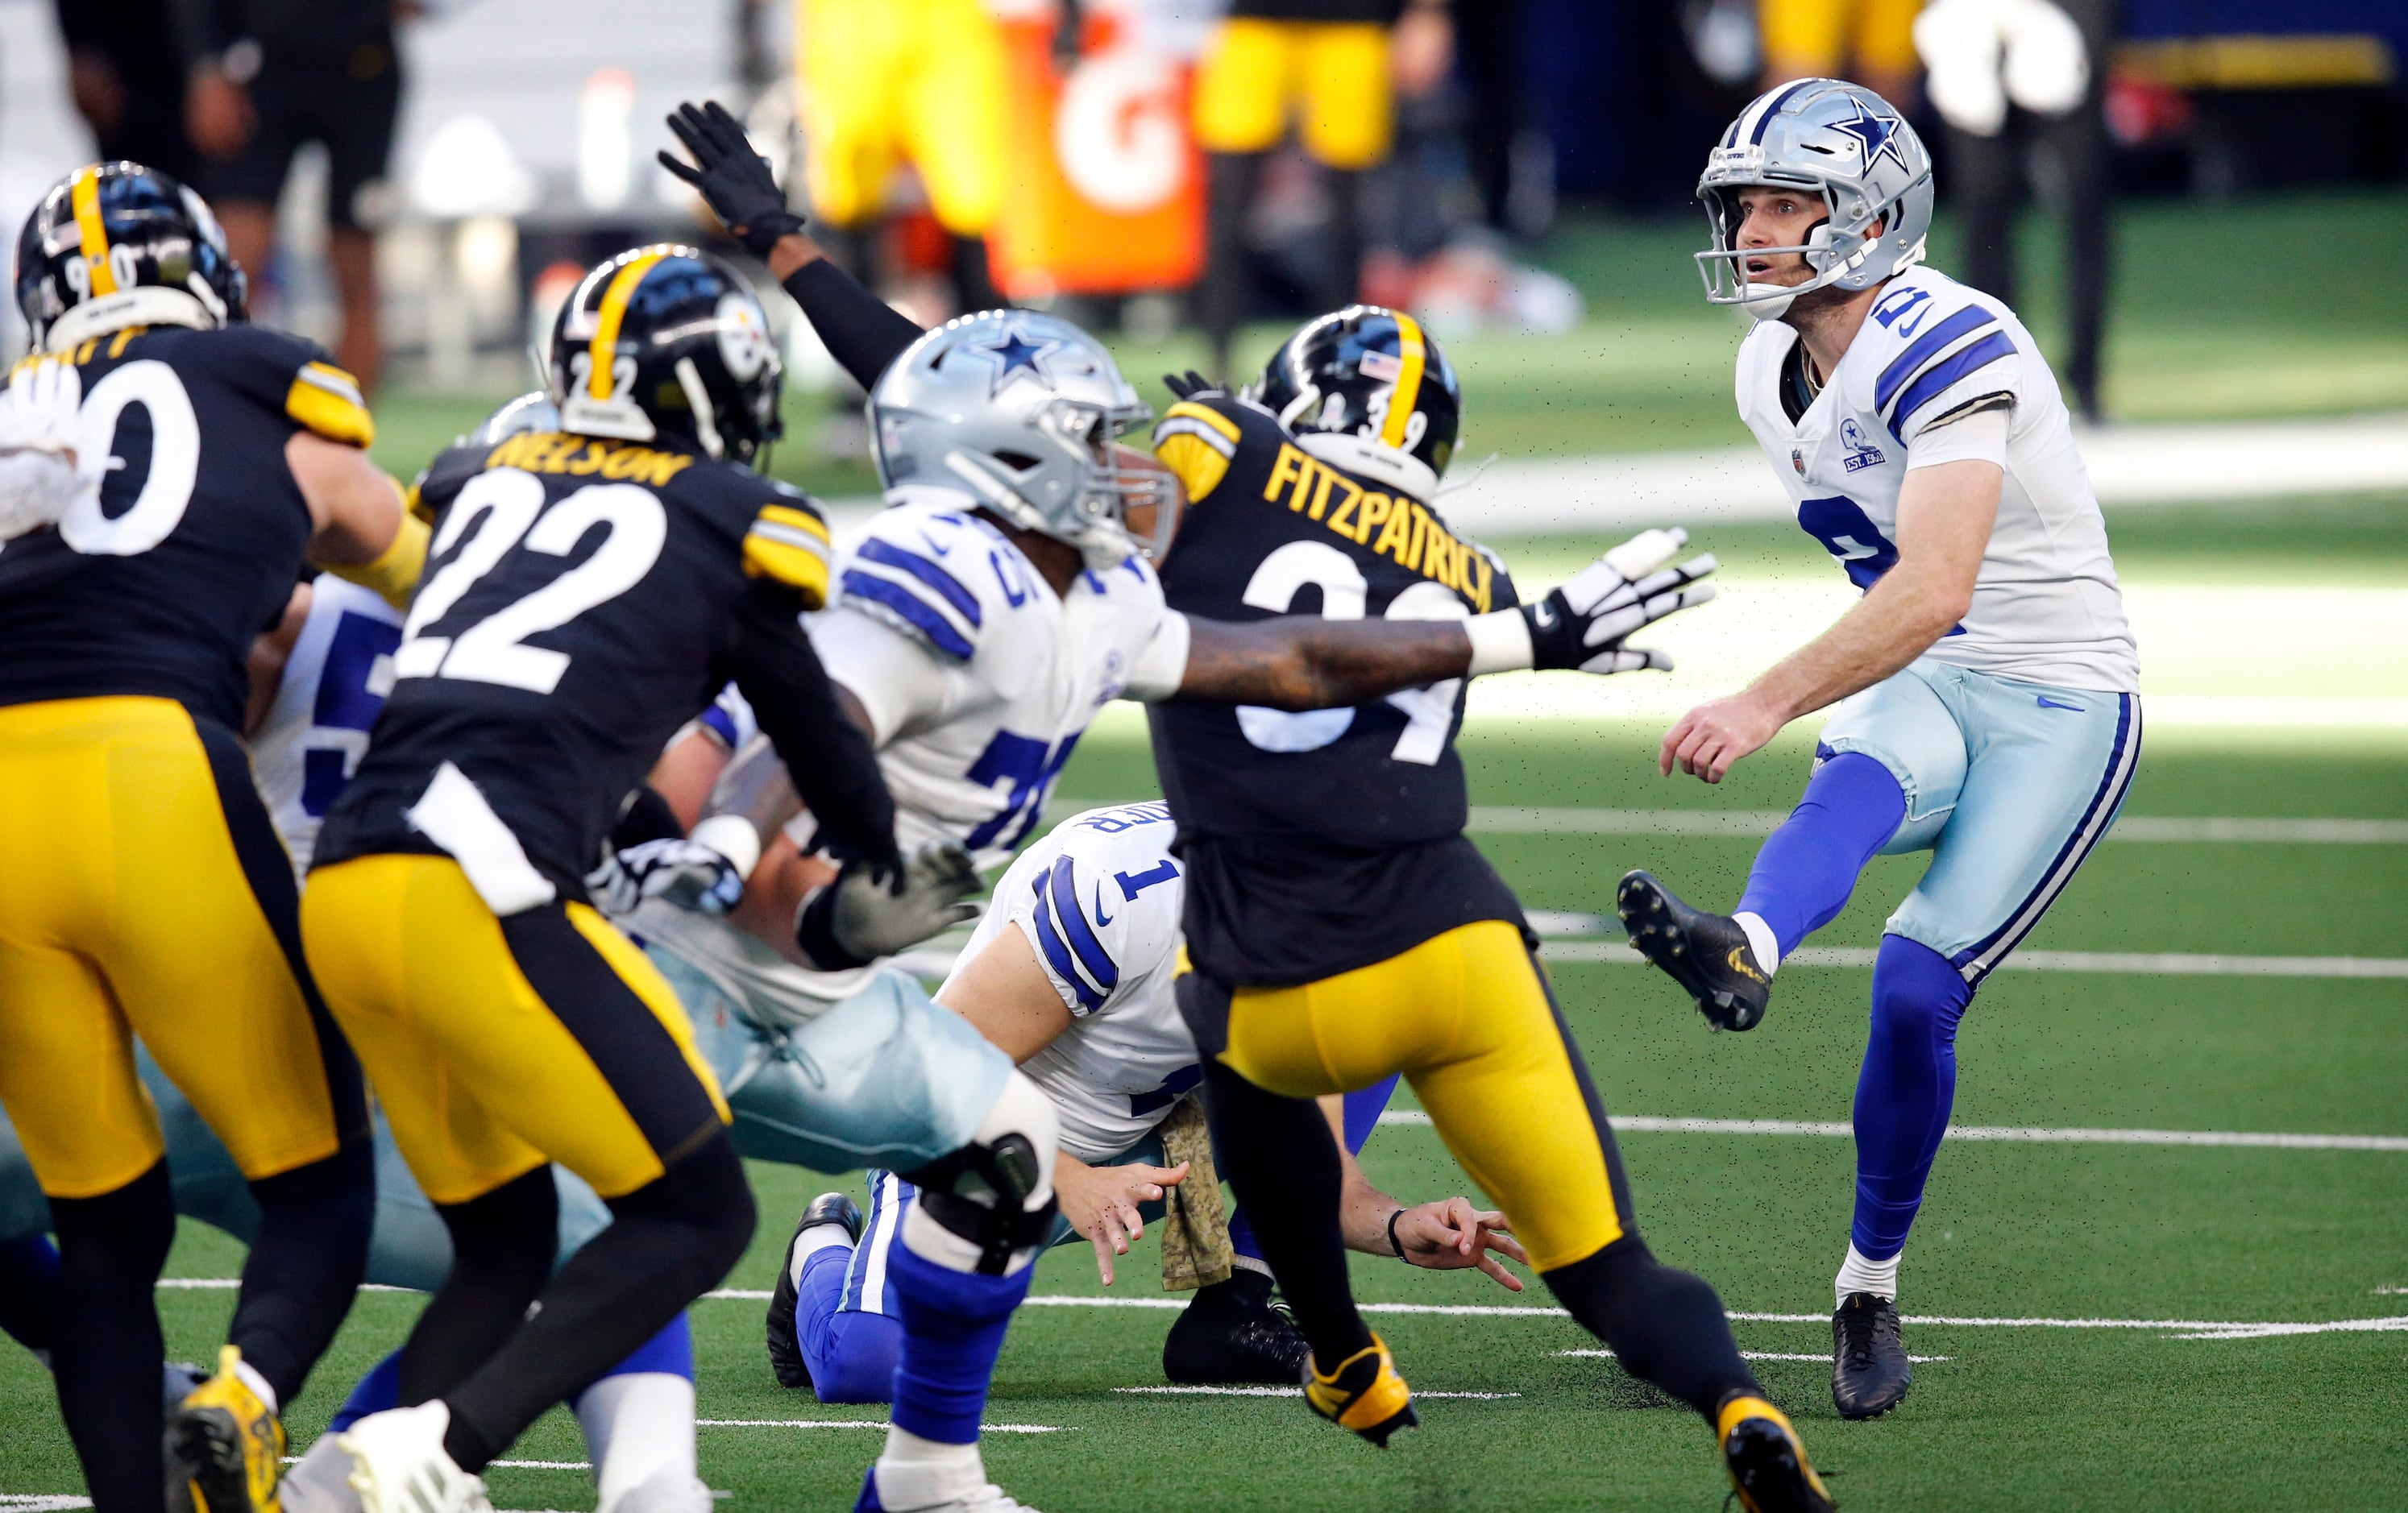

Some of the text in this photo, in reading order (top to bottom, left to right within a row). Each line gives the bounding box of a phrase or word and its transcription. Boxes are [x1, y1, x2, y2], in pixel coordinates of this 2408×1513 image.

[570, 350, 638, 403] 22
[485, 430, 695, 487] NELSON
[1845, 456, 1865, 470] EST.
[1263, 441, 1492, 614] FITZPATRICK
[393, 466, 667, 694] 22
[1113, 859, 1181, 902] 1
